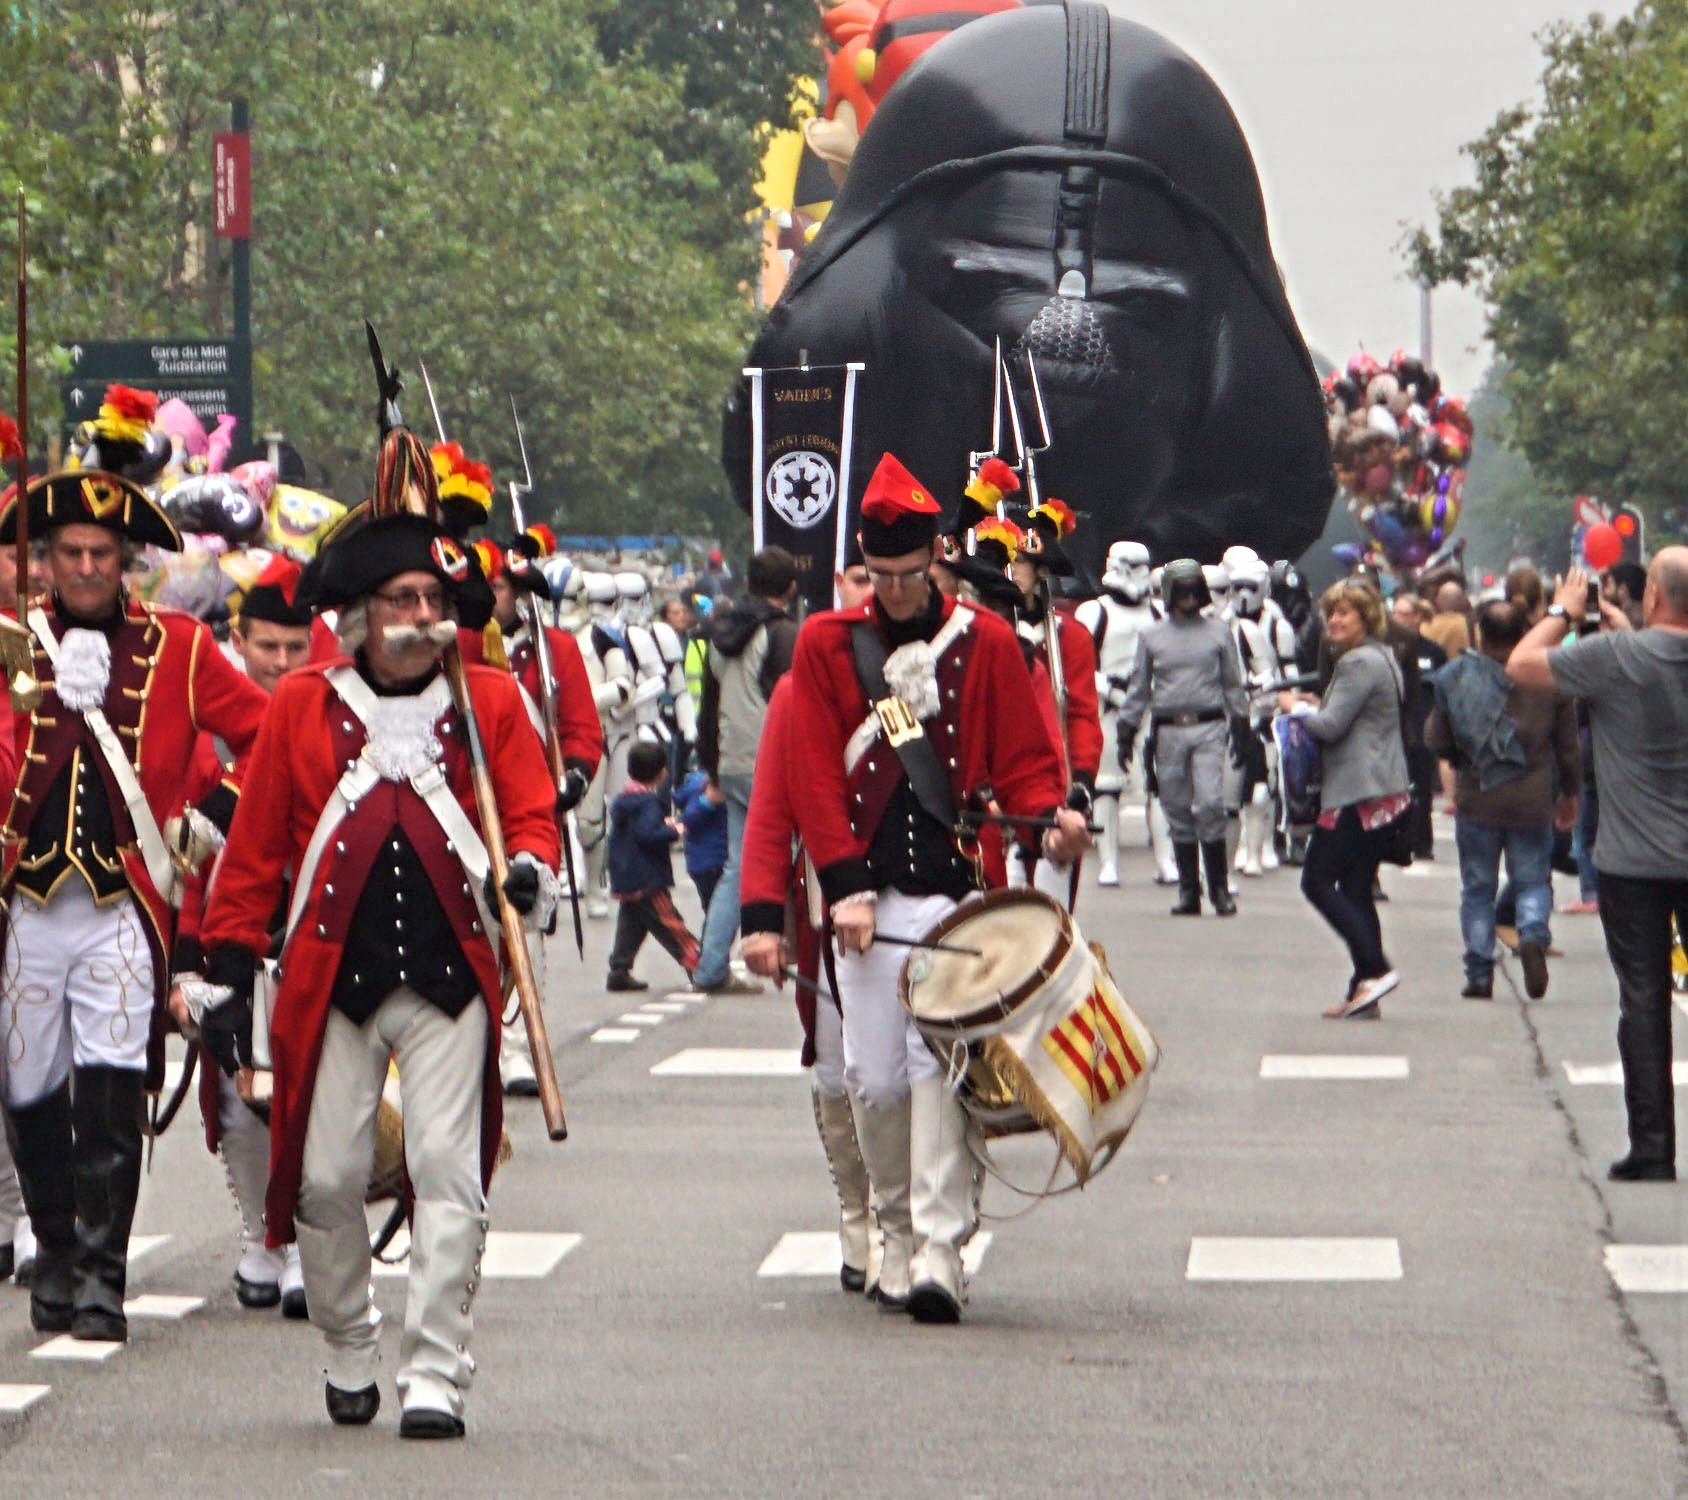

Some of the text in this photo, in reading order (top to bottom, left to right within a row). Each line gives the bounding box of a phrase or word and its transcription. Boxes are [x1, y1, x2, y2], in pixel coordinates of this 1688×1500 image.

[151, 345, 226, 359] Gare du Midi
